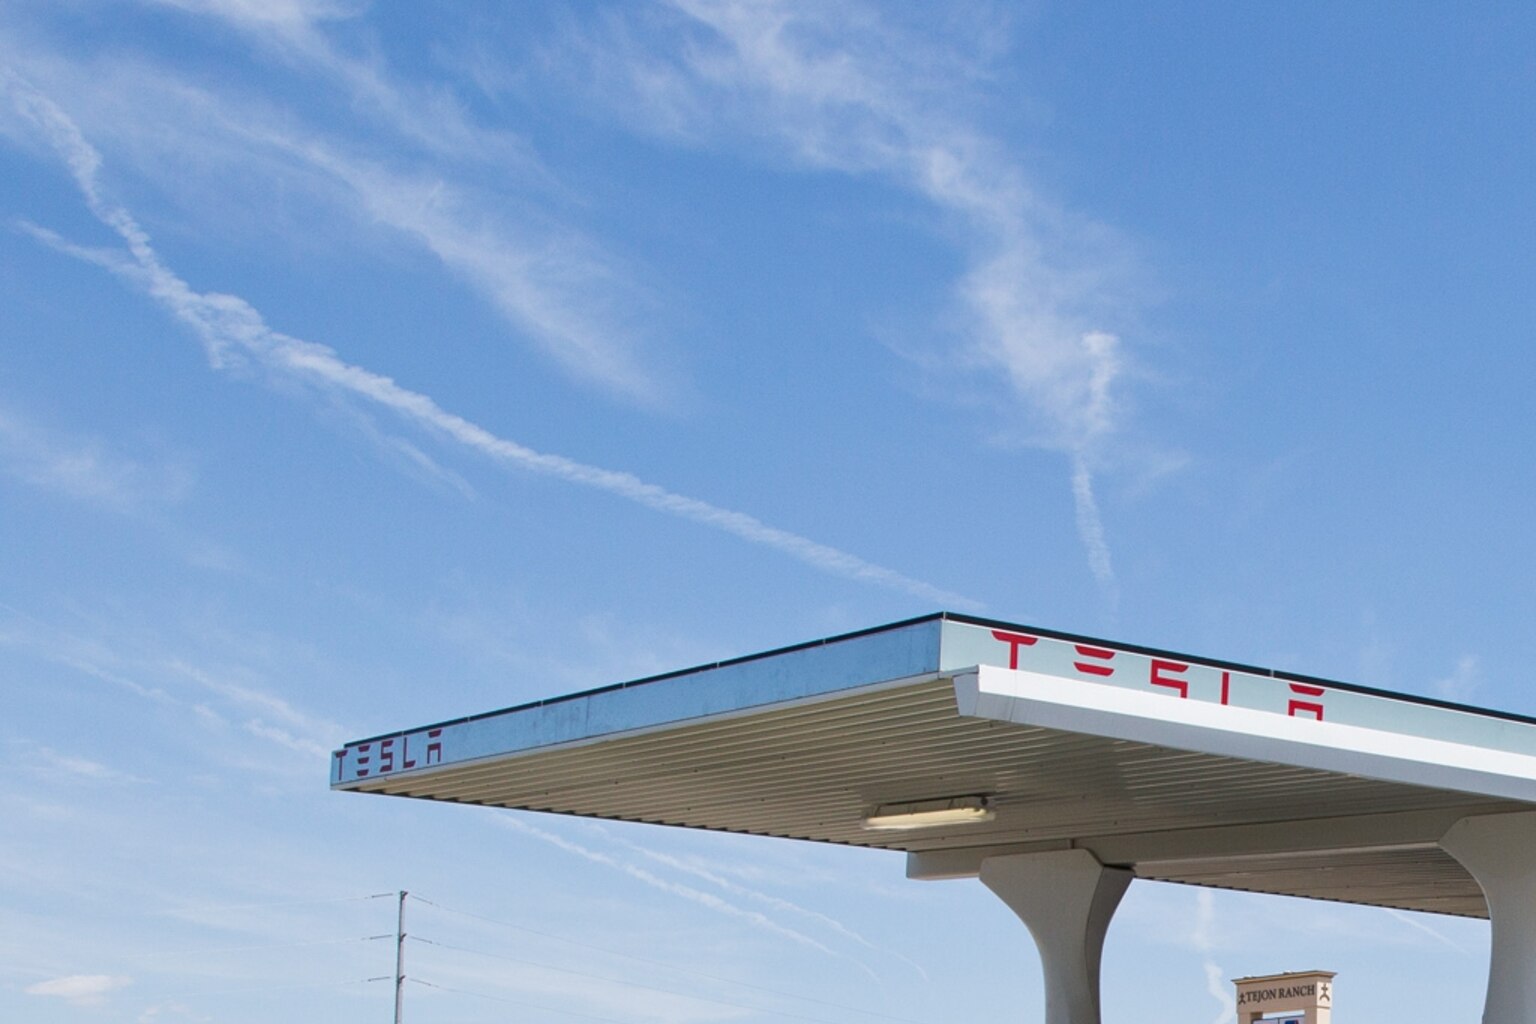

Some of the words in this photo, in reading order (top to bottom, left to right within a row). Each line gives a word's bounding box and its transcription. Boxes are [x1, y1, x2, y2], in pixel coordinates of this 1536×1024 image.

[991, 629, 1324, 722] TESLA
[335, 728, 442, 781] TESLA
[1246, 988, 1277, 1003] TEJON
[1279, 984, 1315, 999] RANCH
